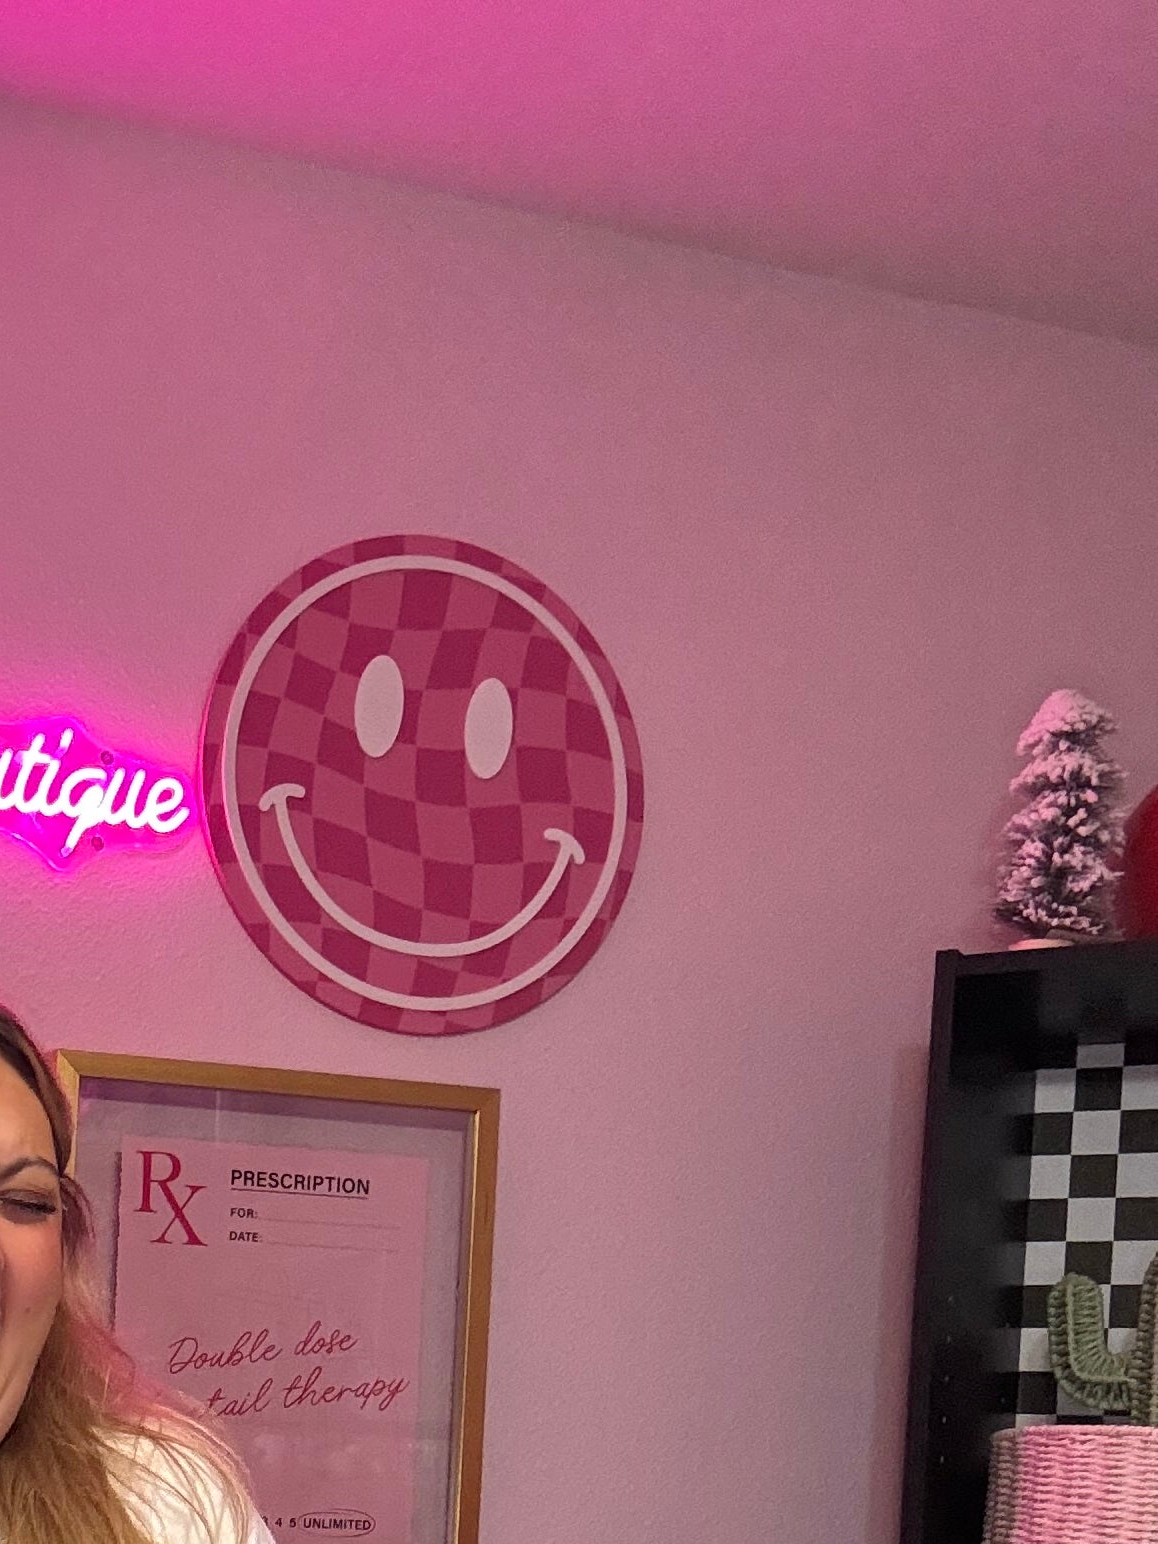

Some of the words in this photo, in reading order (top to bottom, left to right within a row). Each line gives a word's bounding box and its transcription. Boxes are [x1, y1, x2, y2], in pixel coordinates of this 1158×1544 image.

[230, 1169, 371, 1195] PRESCRIPTION
[229, 1207, 259, 1220] FOR:
[228, 1230, 263, 1244] DATE:
[169, 1328, 283, 1375] Double
[293, 1320, 359, 1356] dose
[207, 1378, 274, 1416] tail
[283, 1366, 411, 1411] therapy
[274, 1517, 283, 1528] 4
[289, 1517, 297, 1528] 5
[303, 1517, 372, 1531] UNLIMITED
